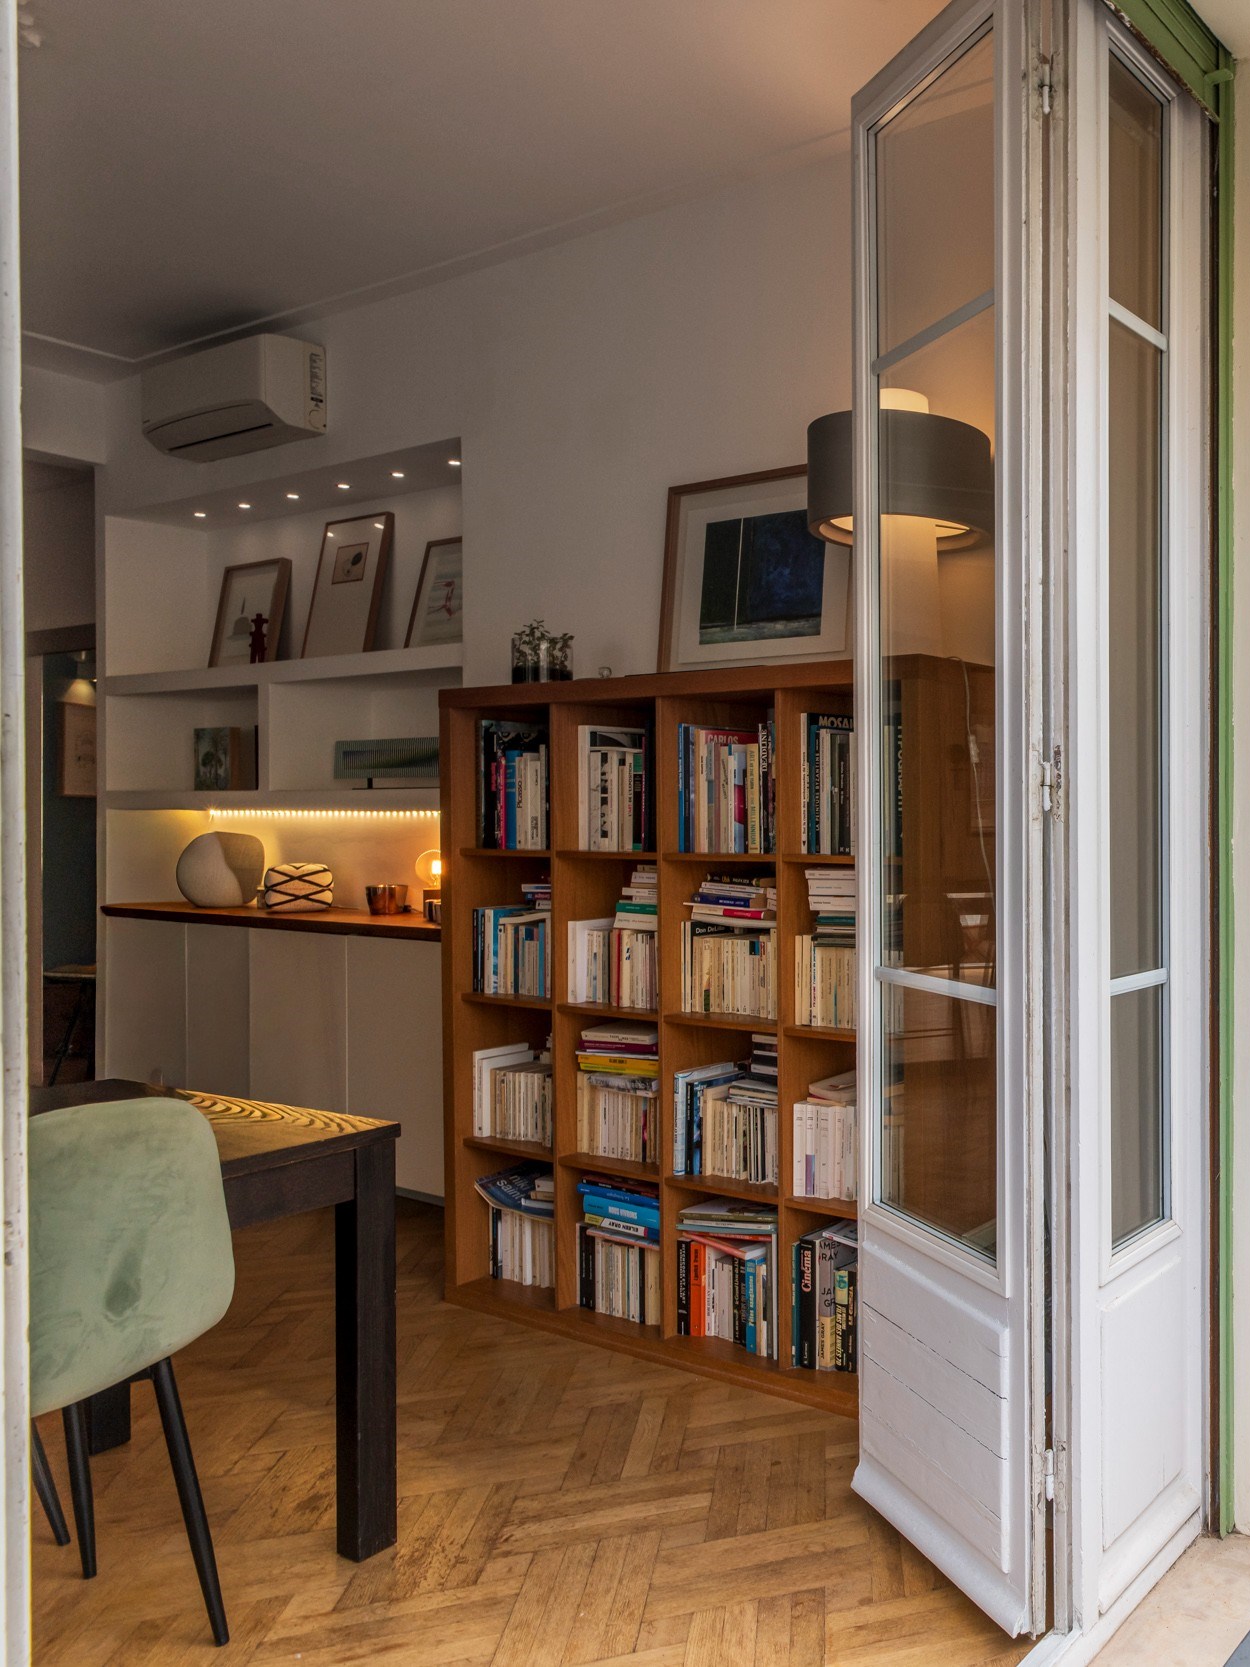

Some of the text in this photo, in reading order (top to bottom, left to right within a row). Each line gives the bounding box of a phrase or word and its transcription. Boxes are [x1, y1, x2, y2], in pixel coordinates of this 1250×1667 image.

[707, 734, 739, 745] CARLOS
[608, 1221, 639, 1233] EILEEN GRAY
[801, 1250, 812, 1292] Cinéma
